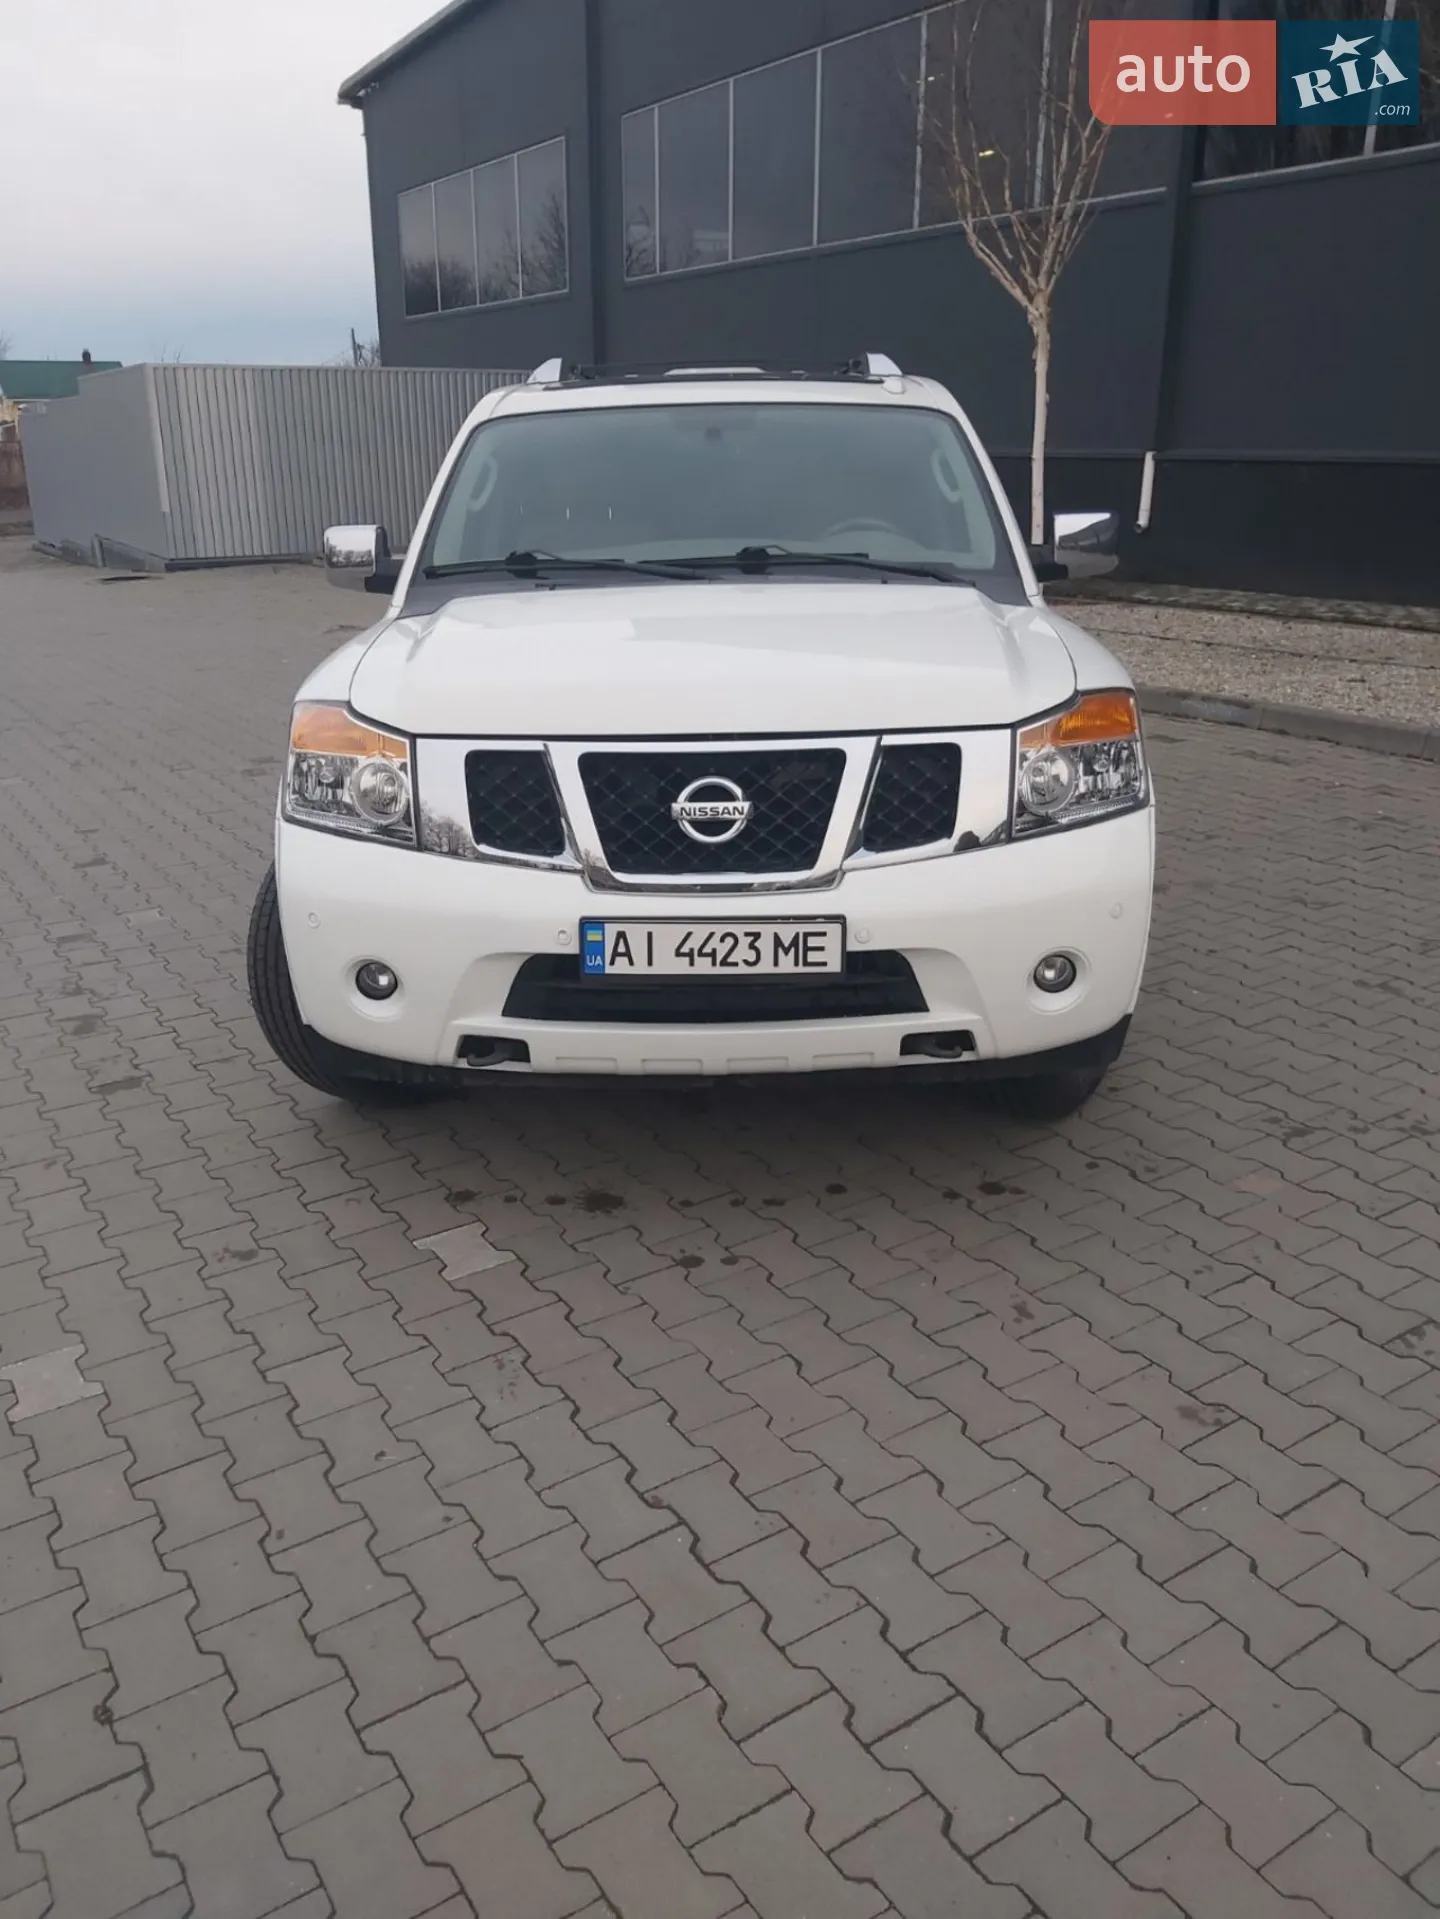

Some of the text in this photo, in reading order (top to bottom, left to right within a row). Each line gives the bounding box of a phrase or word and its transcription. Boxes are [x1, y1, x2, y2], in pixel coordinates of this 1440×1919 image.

[680, 806, 744, 817] NISSAN
[609, 930, 828, 967] AI 4423 ME
[587, 955, 604, 967] UA
